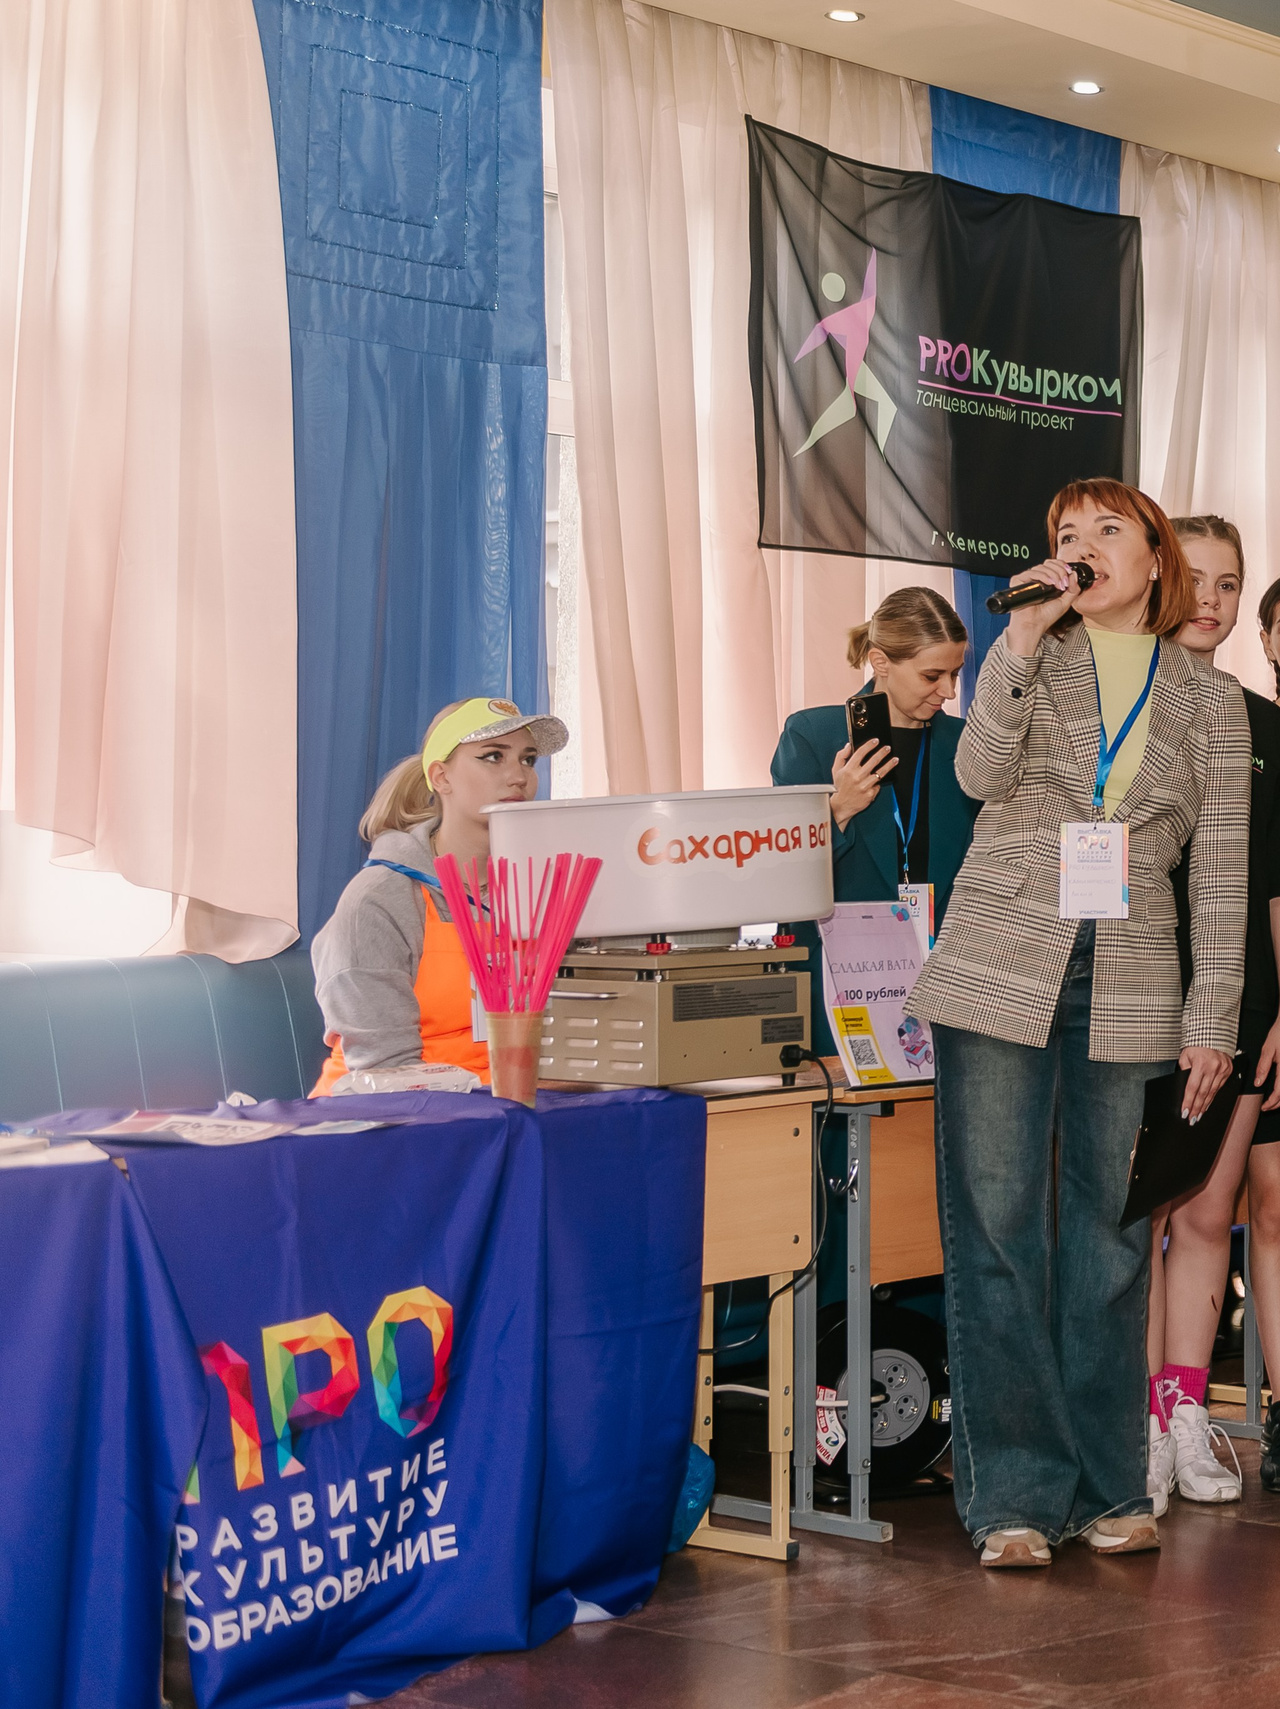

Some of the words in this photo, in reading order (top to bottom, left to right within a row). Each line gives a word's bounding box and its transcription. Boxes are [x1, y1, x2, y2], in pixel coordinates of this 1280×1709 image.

[916, 389, 1016, 423] танцевальный
[1020, 410, 1075, 431] проект
[637, 825, 802, 868] Сахарная
[809, 822, 829, 848] ва
[830, 960, 885, 974] СЛАДКАЯ
[887, 959, 916, 971] ВАТА
[844, 988, 863, 1001] 100
[866, 986, 907, 1002] рублей
[176, 1438, 447, 1558] РАЗВИТИЕ
[183, 1480, 449, 1606] КУЛЬТУРУ
[186, 1523, 459, 1652] ОБРАЗОВАНИЕ
